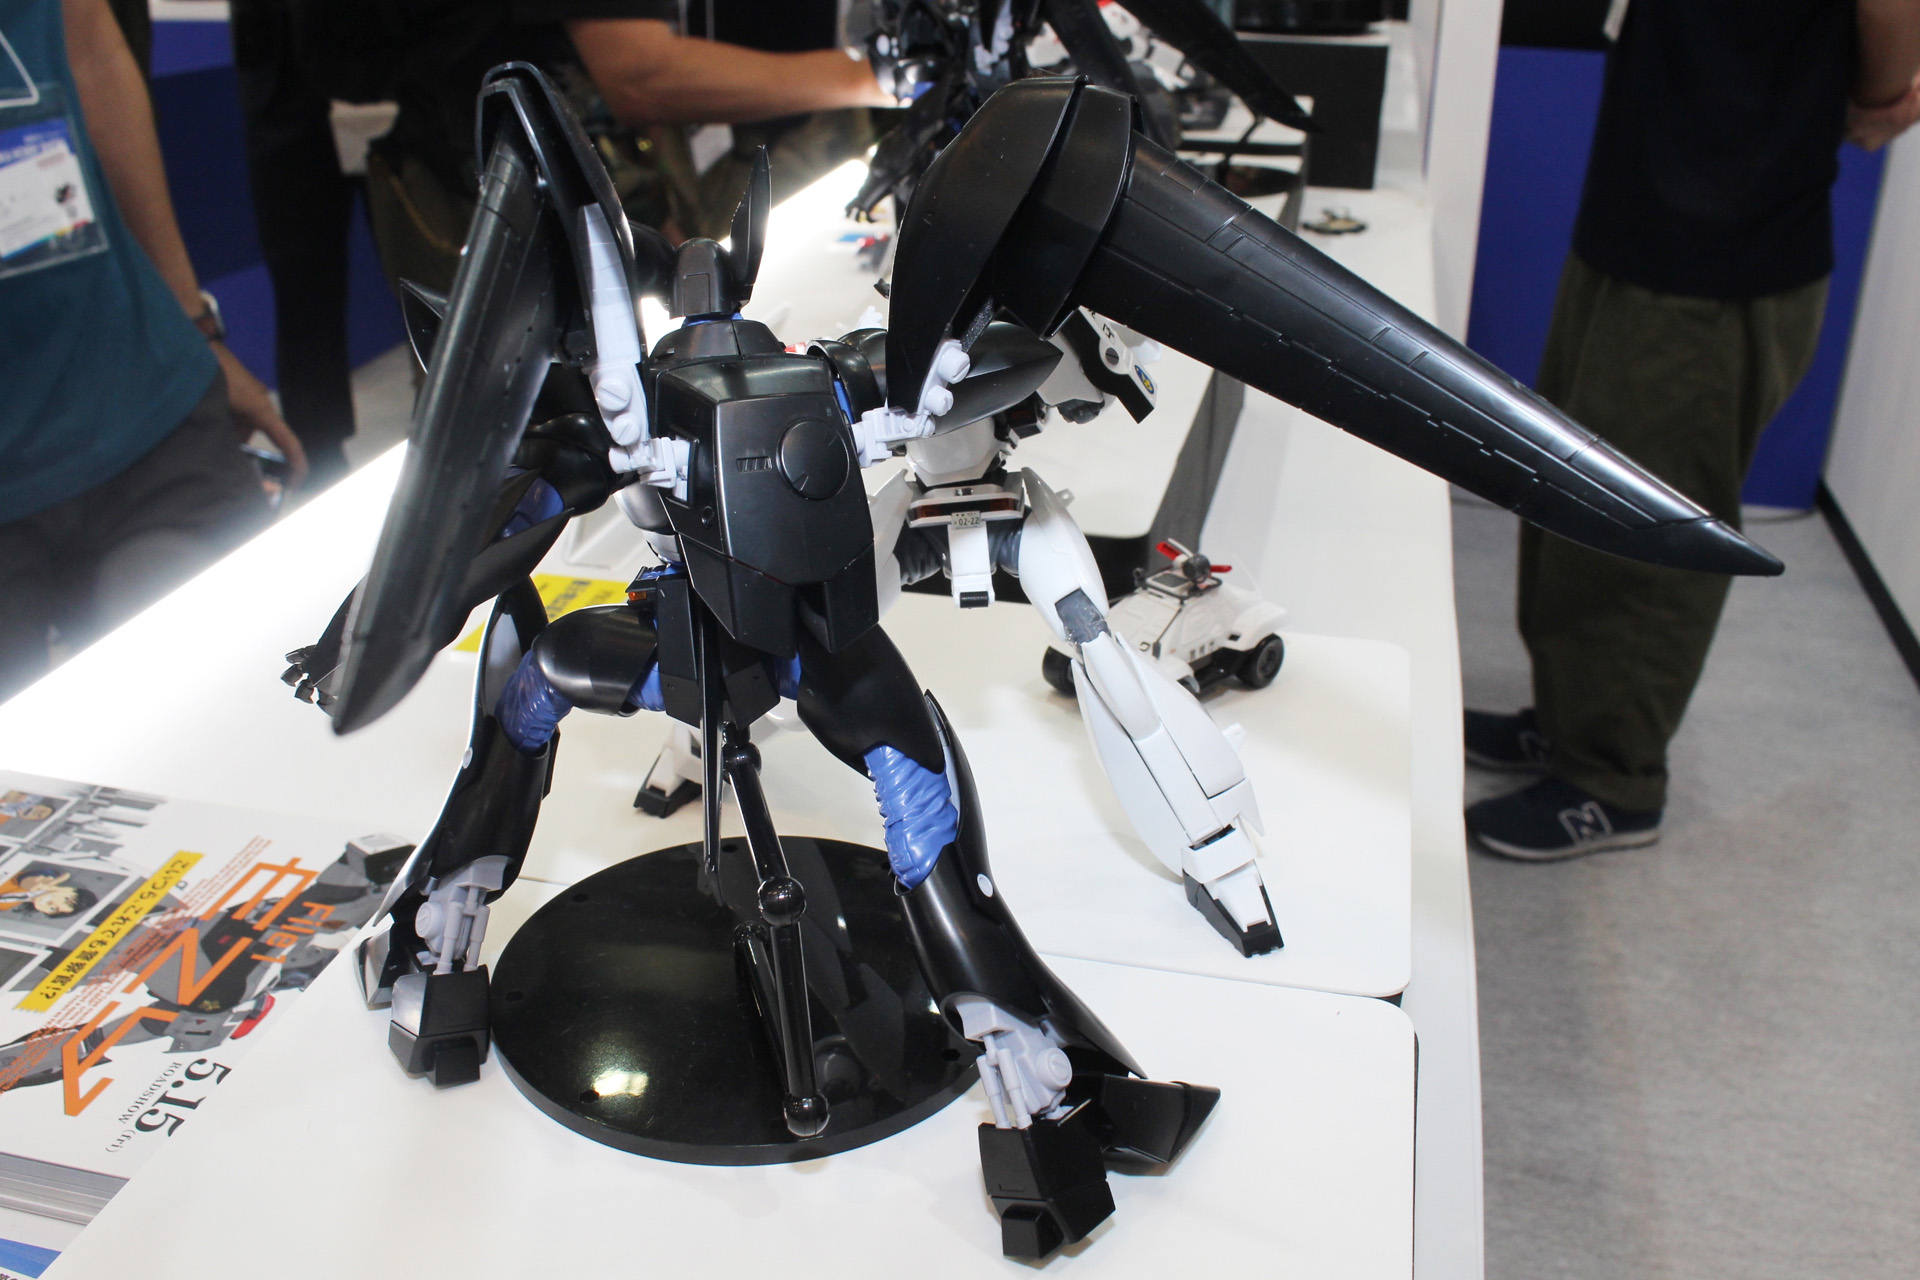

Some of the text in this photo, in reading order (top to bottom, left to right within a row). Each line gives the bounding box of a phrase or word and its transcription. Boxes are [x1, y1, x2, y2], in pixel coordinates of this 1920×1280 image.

[265, 901, 336, 949] File
[118, 1061, 182, 1124] ROADSHOW
[135, 1058, 232, 1138] 5.15
